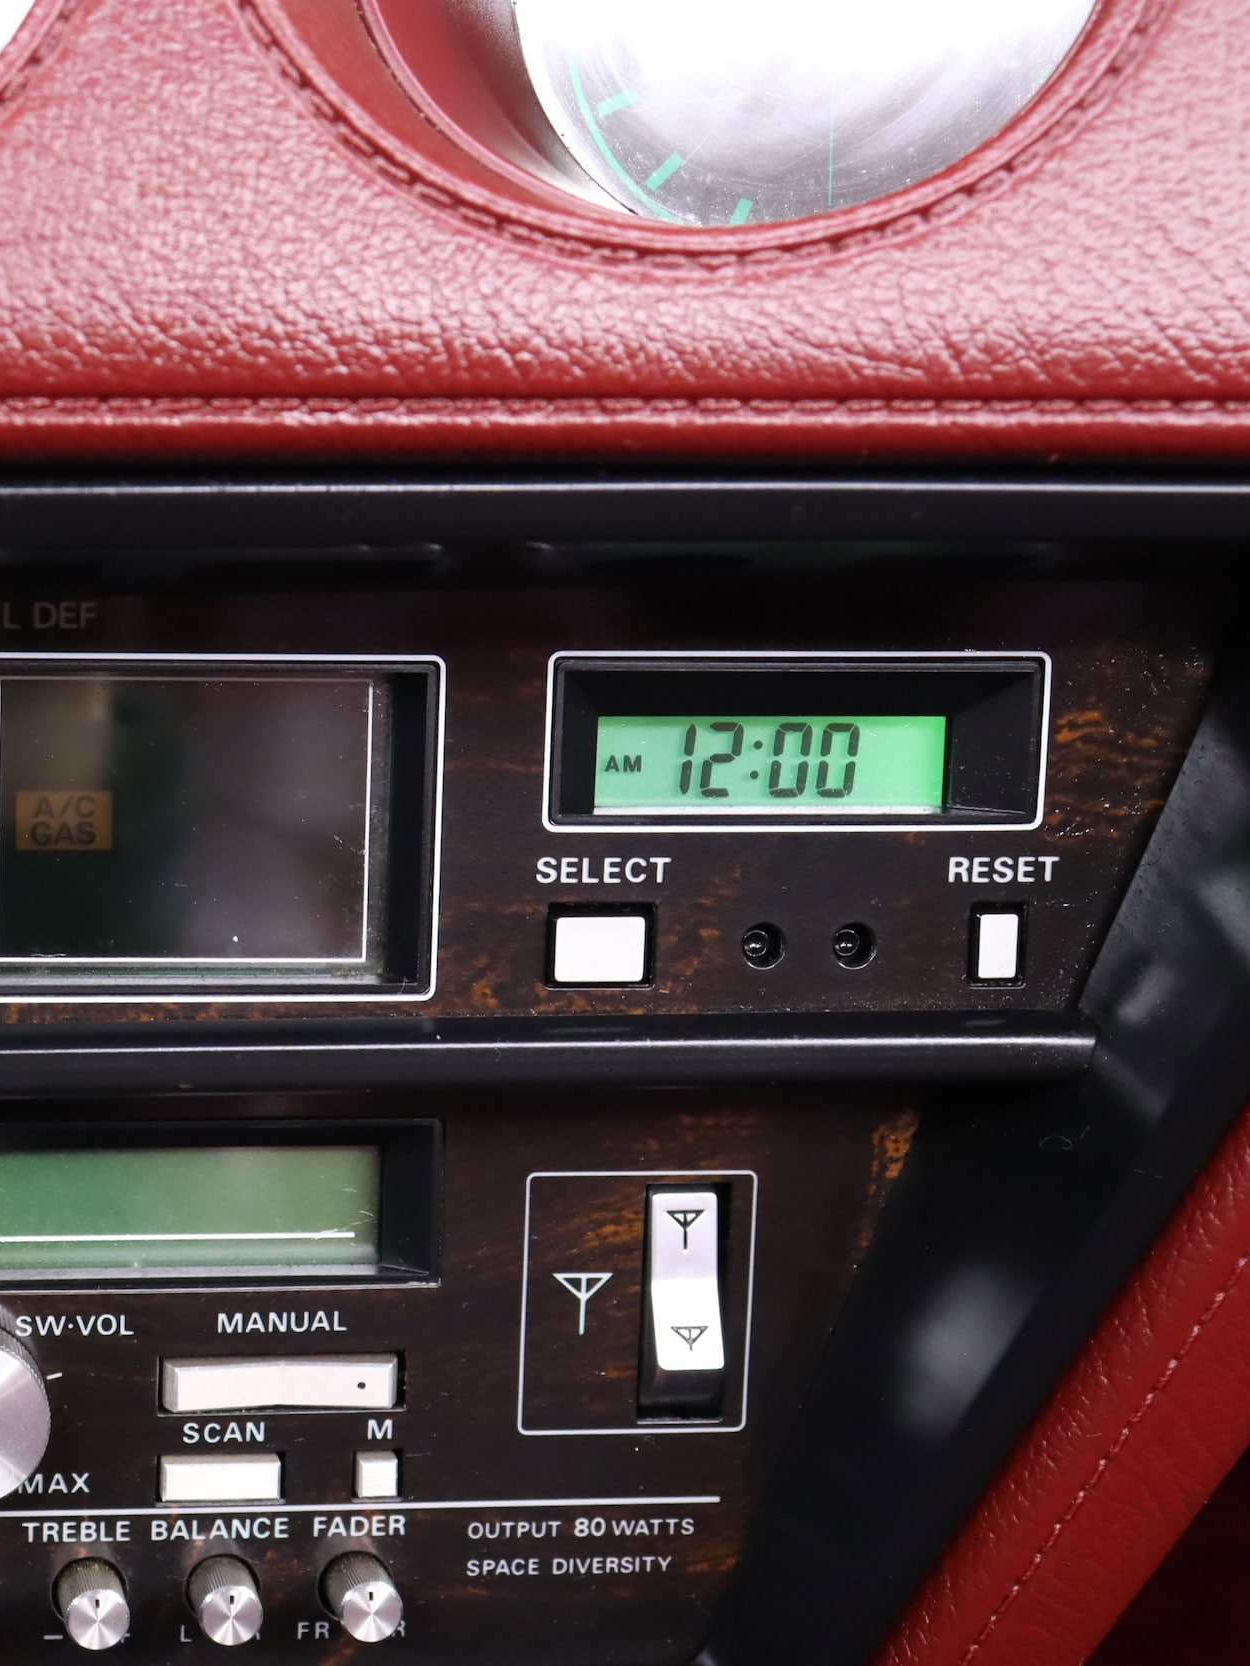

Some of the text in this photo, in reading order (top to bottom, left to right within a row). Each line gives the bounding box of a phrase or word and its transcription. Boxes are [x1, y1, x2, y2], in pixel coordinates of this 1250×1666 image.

[32, 602, 98, 629] DEF
[604, 721, 861, 799] AM 12:00
[33, 794, 95, 820] A/C
[30, 821, 96, 847] GAS
[535, 856, 672, 885] SELECT
[947, 855, 1060, 884] RESET
[217, 1309, 348, 1334] MANUAL
[182, 1421, 267, 1445] SCAN
[367, 1419, 393, 1440] M
[18, 1473, 91, 1495] MAX
[21, 1521, 132, 1543] TREBLE
[150, 1518, 290, 1541] BALANCE
[312, 1515, 407, 1538] FADER
[466, 1516, 696, 1540] OUTPUT 80 WATTS
[465, 1556, 672, 1577] SPACE DIVERSITY
[179, 1624, 192, 1643] L
[297, 1621, 330, 1640] FR
